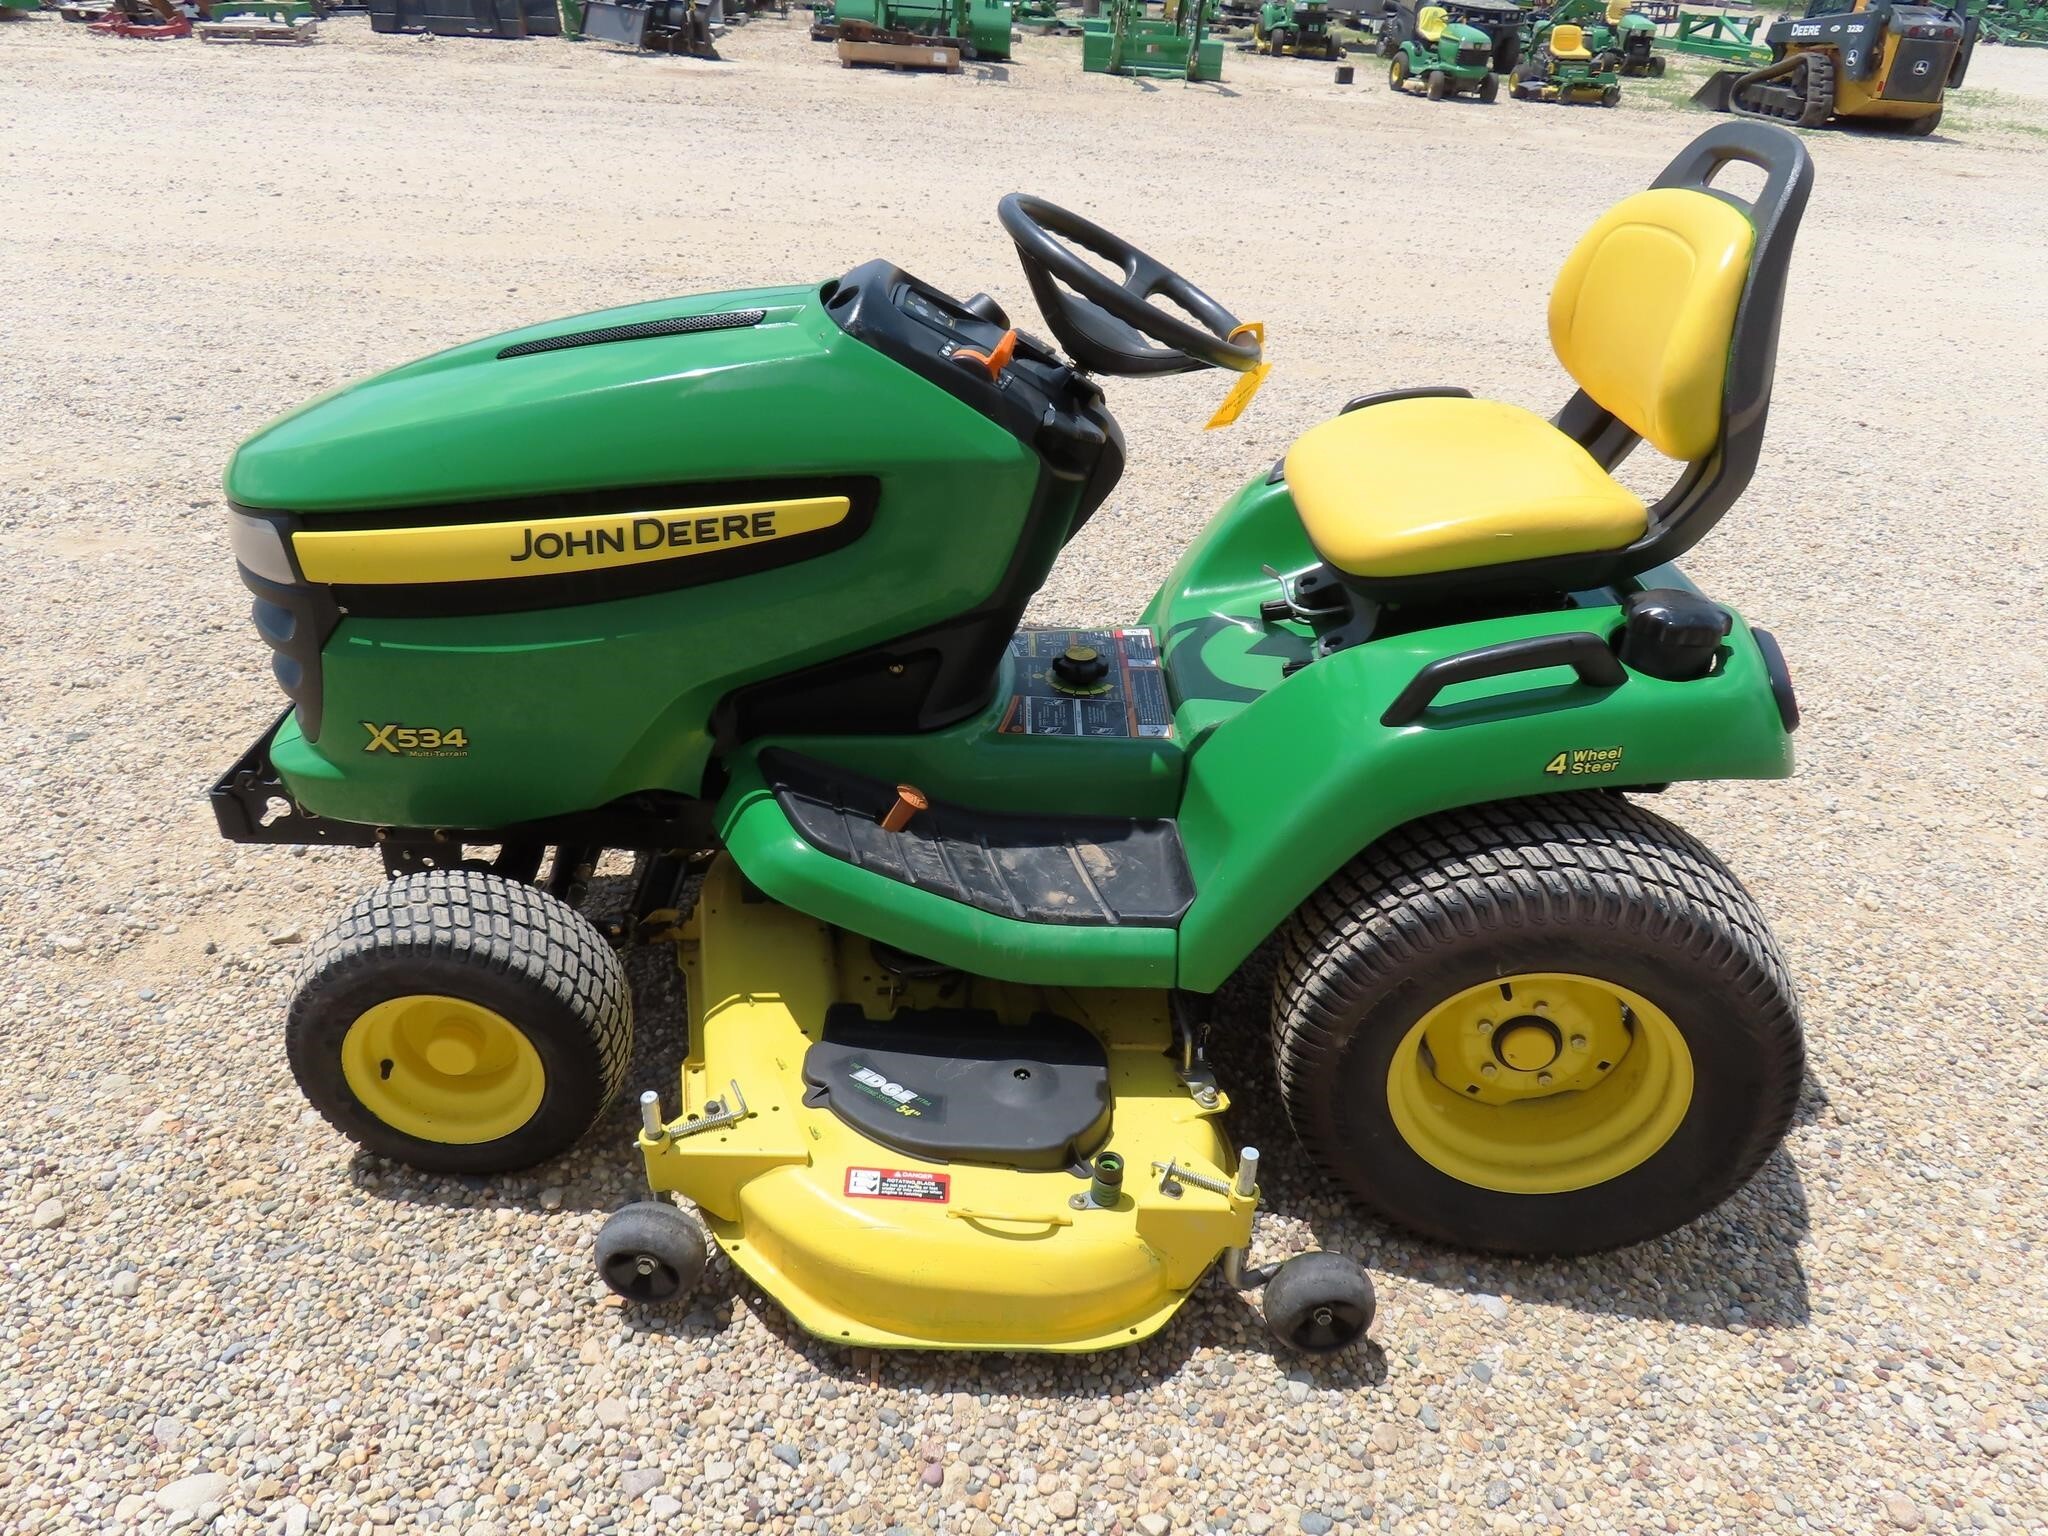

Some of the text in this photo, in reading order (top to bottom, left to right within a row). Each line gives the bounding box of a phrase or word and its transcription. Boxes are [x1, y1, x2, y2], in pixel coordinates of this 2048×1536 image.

[1791, 23, 1821, 36] DEERE
[511, 511, 775, 561] JOHN DEERE
[363, 722, 468, 753] X534
[409, 750, 468, 758] Multi-Terrain
[1573, 746, 1623, 762] Wheel
[1545, 753, 1567, 775] 4
[1571, 761, 1620, 775] Steer
[849, 1067, 919, 1104] EDGE
[895, 1104, 922, 1117] 54"
